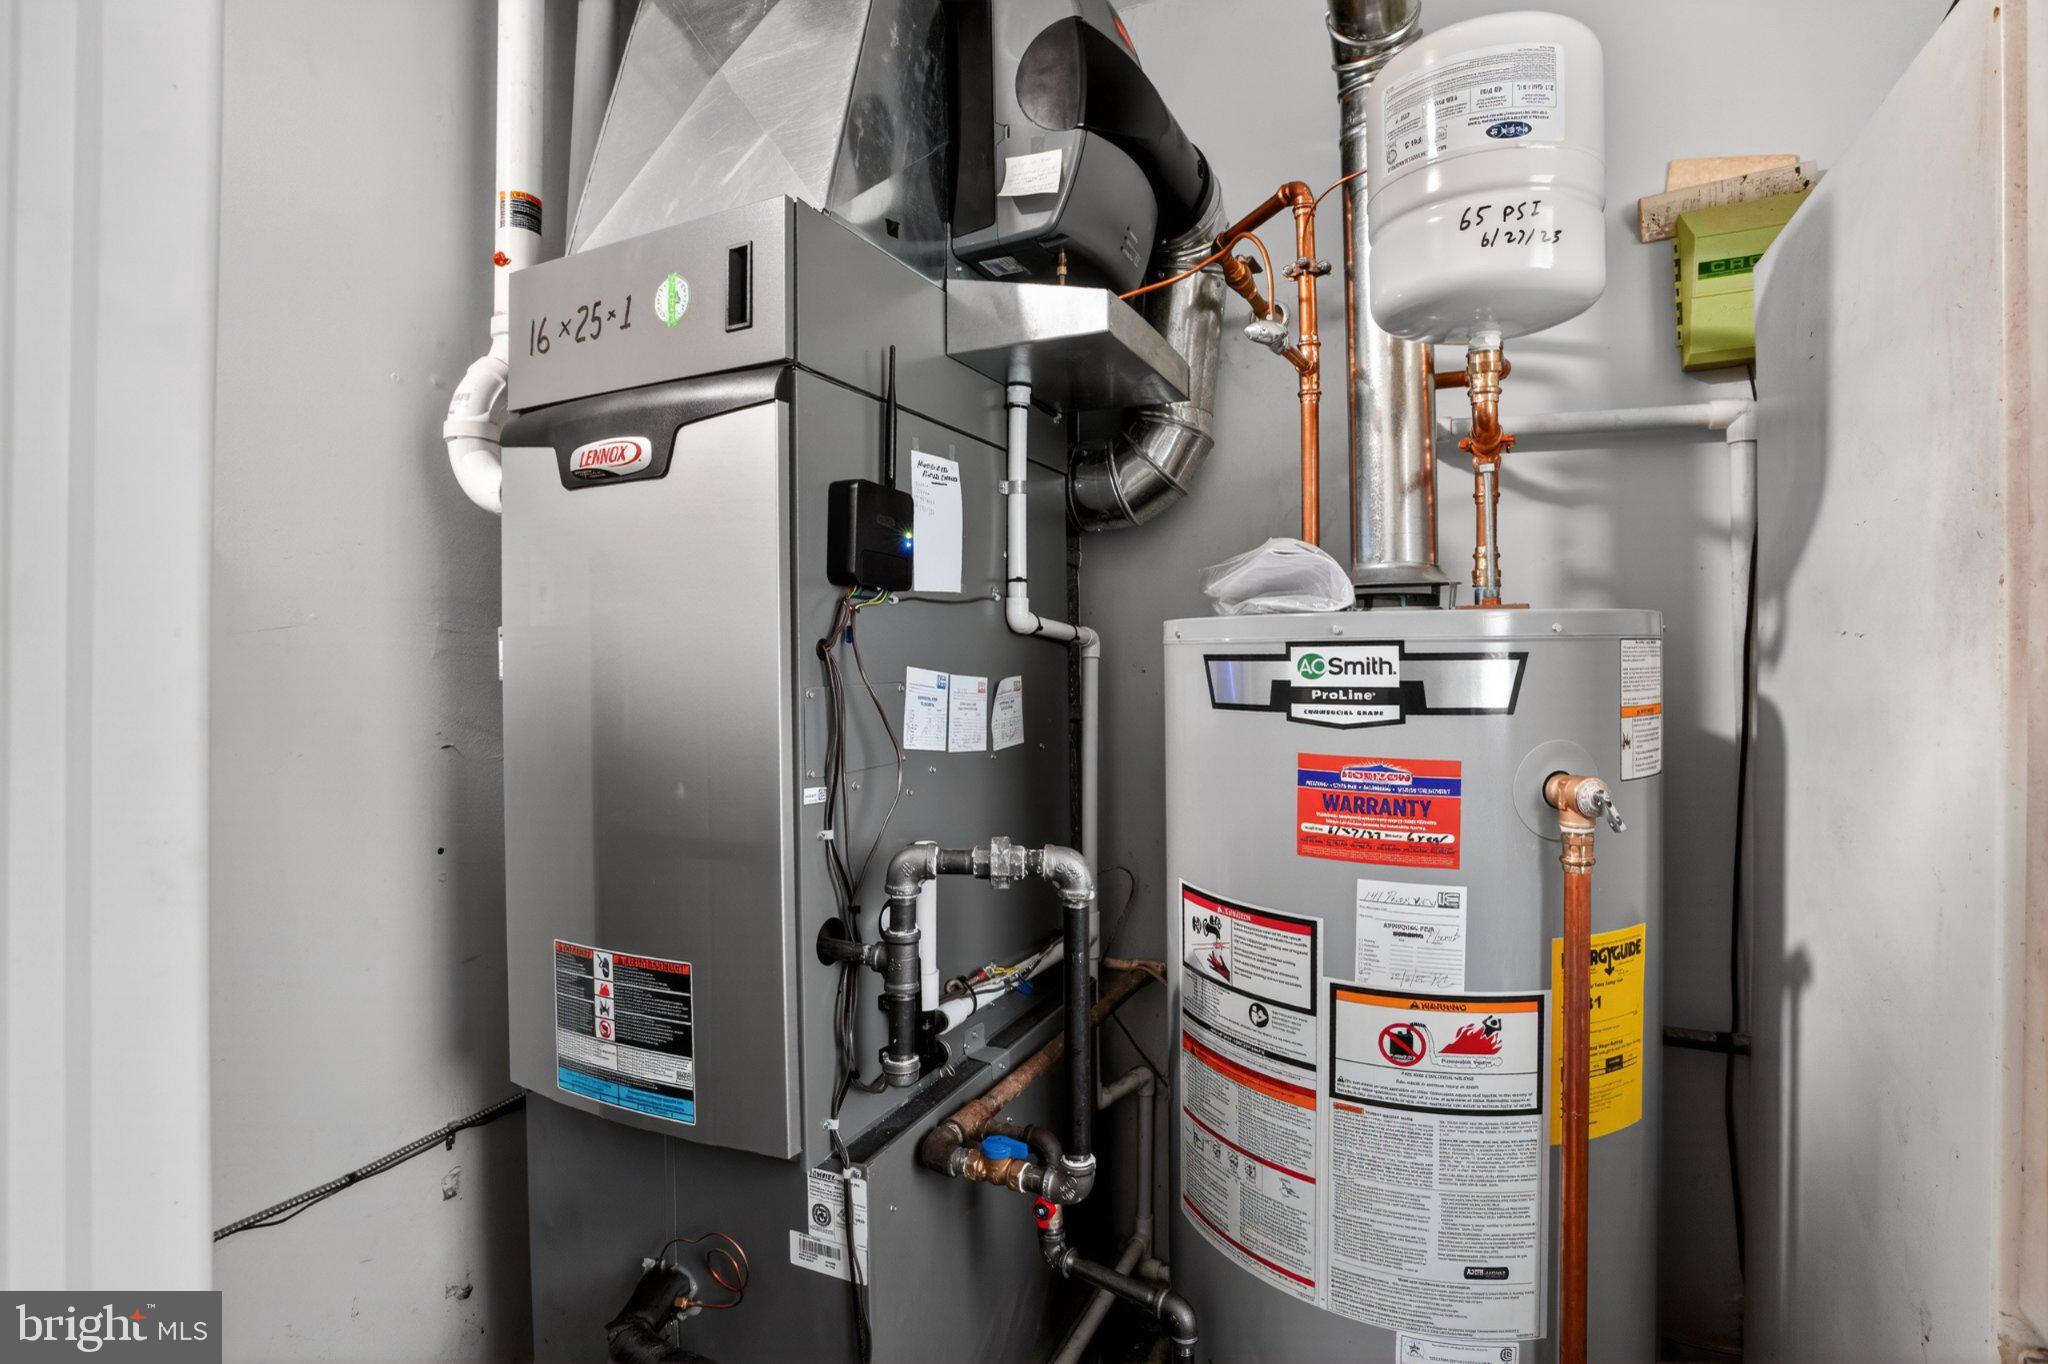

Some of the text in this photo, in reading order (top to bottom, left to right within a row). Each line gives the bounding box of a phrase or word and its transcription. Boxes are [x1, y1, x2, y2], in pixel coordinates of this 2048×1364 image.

[1460, 199, 1541, 231] 65 PSI
[580, 445, 628, 468] LENNOX
[1312, 689, 1373, 701] ProLine
[1322, 794, 1432, 818] WARRANTY
[1420, 1001, 1467, 1012] WARNING
